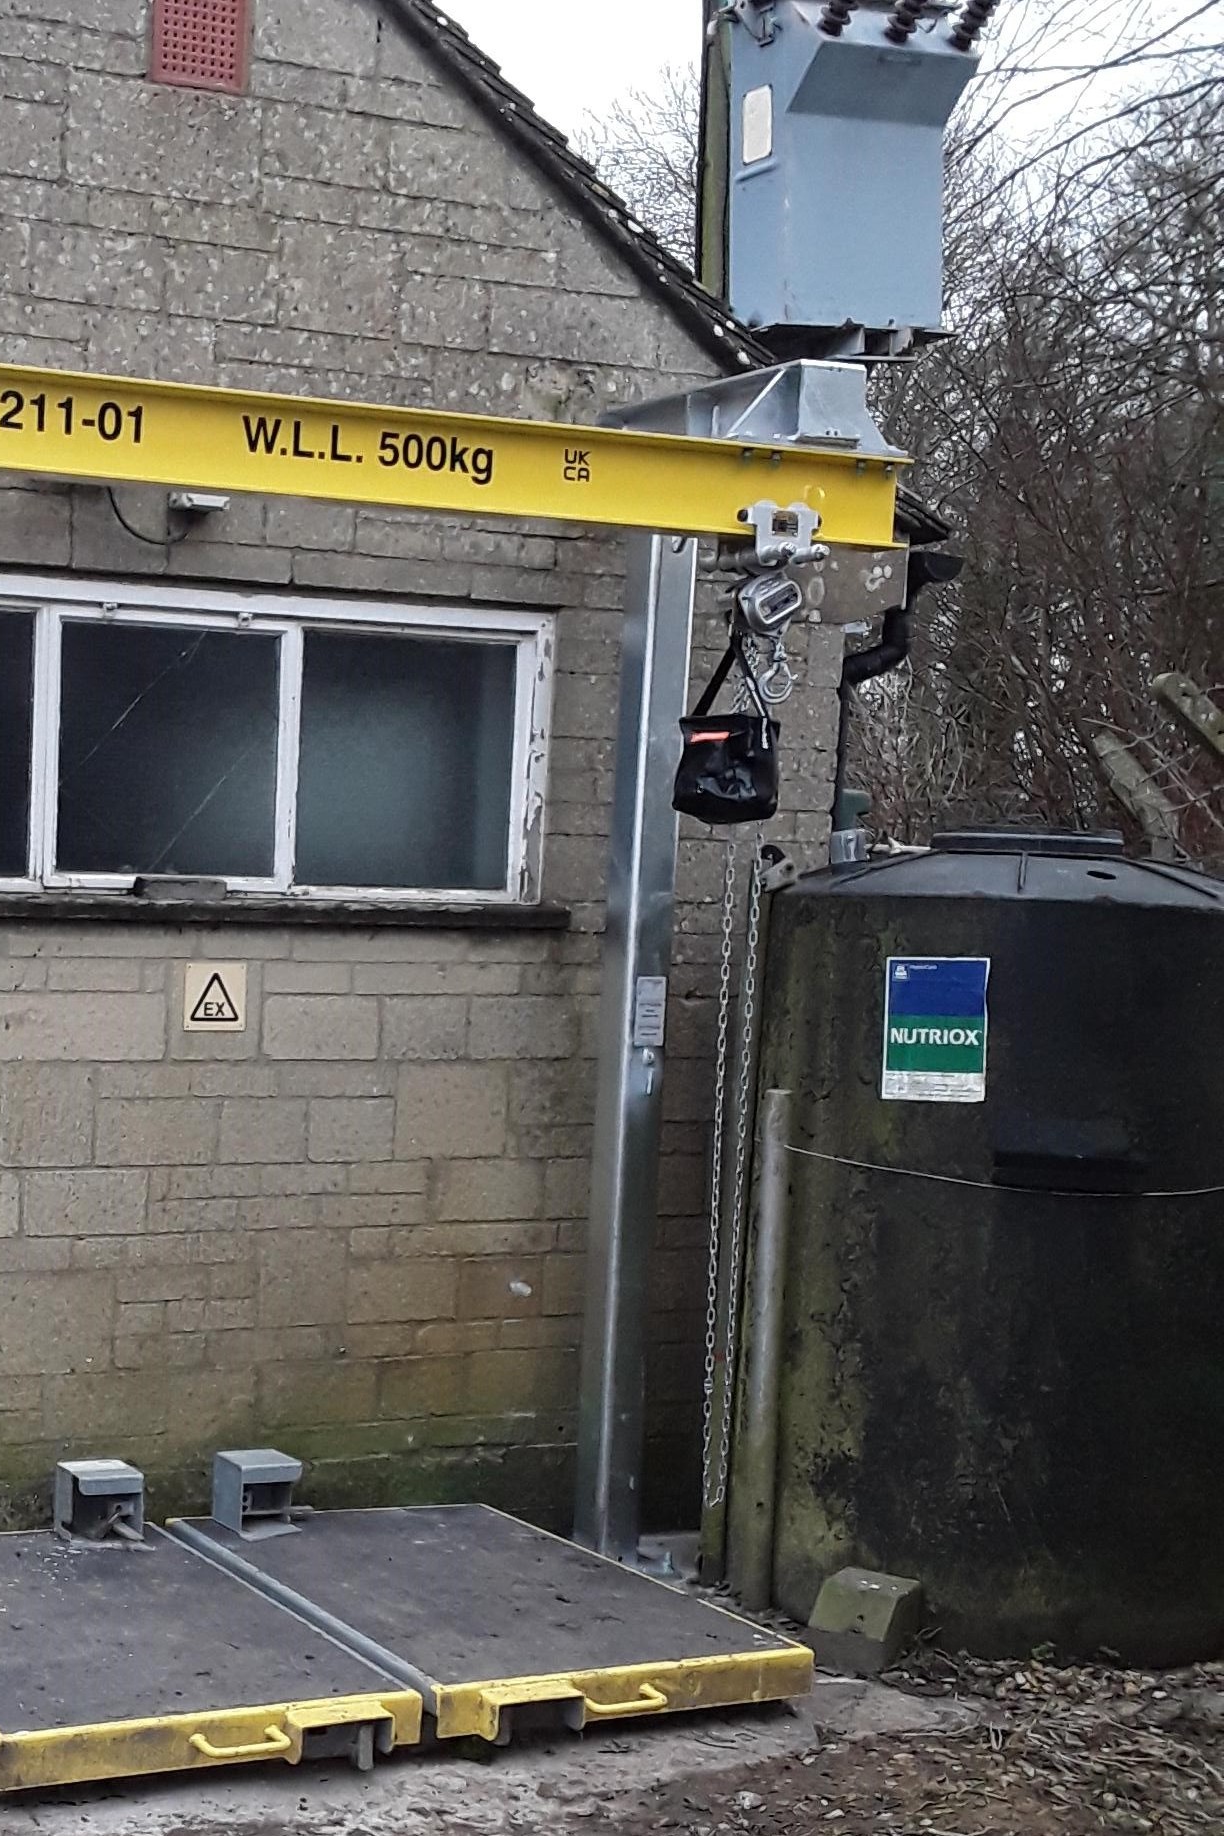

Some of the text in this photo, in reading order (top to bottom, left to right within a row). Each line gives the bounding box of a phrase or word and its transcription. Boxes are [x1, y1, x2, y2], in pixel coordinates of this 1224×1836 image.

[242, 414, 494, 486] W.L.L. 500kg
[563, 448, 591, 466] UK
[562, 466, 591, 483] CA
[203, 1002, 226, 1017] EX
[889, 1027, 980, 1046] NUTRIOX
